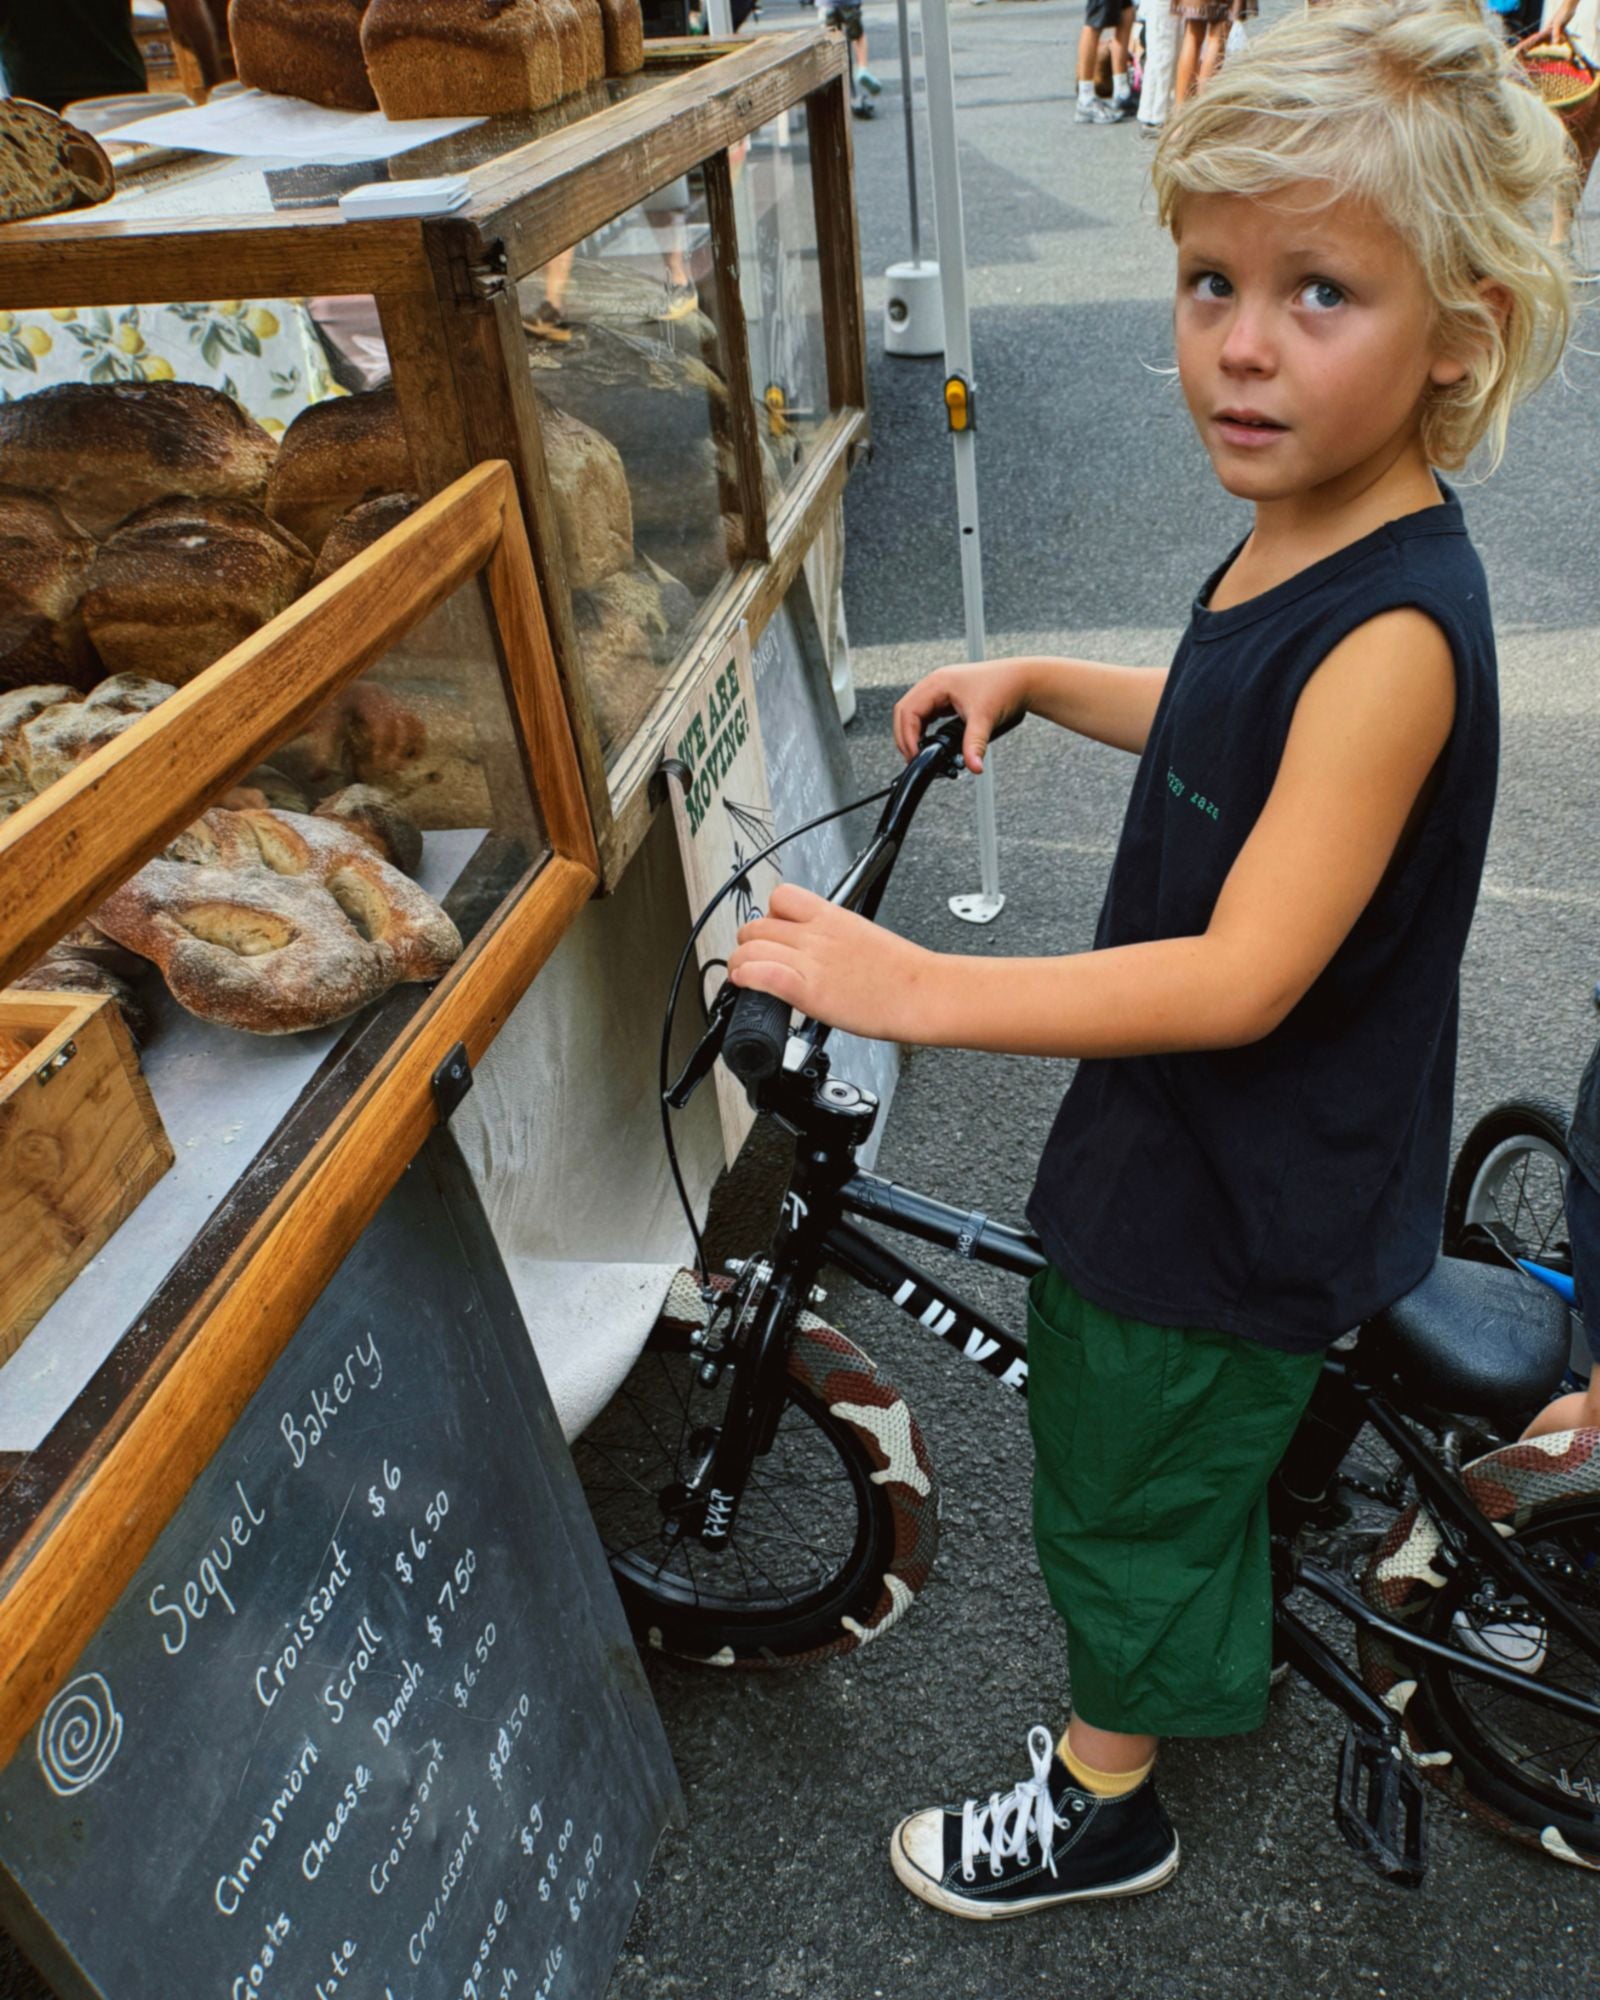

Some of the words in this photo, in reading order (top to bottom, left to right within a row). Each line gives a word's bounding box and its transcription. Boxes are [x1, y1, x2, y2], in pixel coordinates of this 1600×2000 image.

[677, 708, 708, 772] WE
[708, 656, 741, 739] ARE
[684, 697, 750, 840] MOVING!
[149, 1479, 266, 1655] Sequel
[279, 1331, 383, 1469] Bakery
[255, 1540, 351, 1707] Croissant
[367, 1458, 402, 1518] $6
[215, 1740, 320, 1915] Cinnamon
[323, 1616, 383, 1724] Scroll
[395, 1490, 450, 1585] $6.50
[370, 1738, 444, 1896] Croissant
[453, 1621, 497, 1709] $6.50
[233, 1912, 291, 2000] Goats
[302, 1764, 371, 1881] Cheese
[372, 1658, 425, 1747] Danish
[408, 1804, 481, 1966] Croissant
[521, 1802, 544, 1856] $9
[538, 1818, 574, 1903] $8.00
[569, 1832, 603, 1923] $6.50
